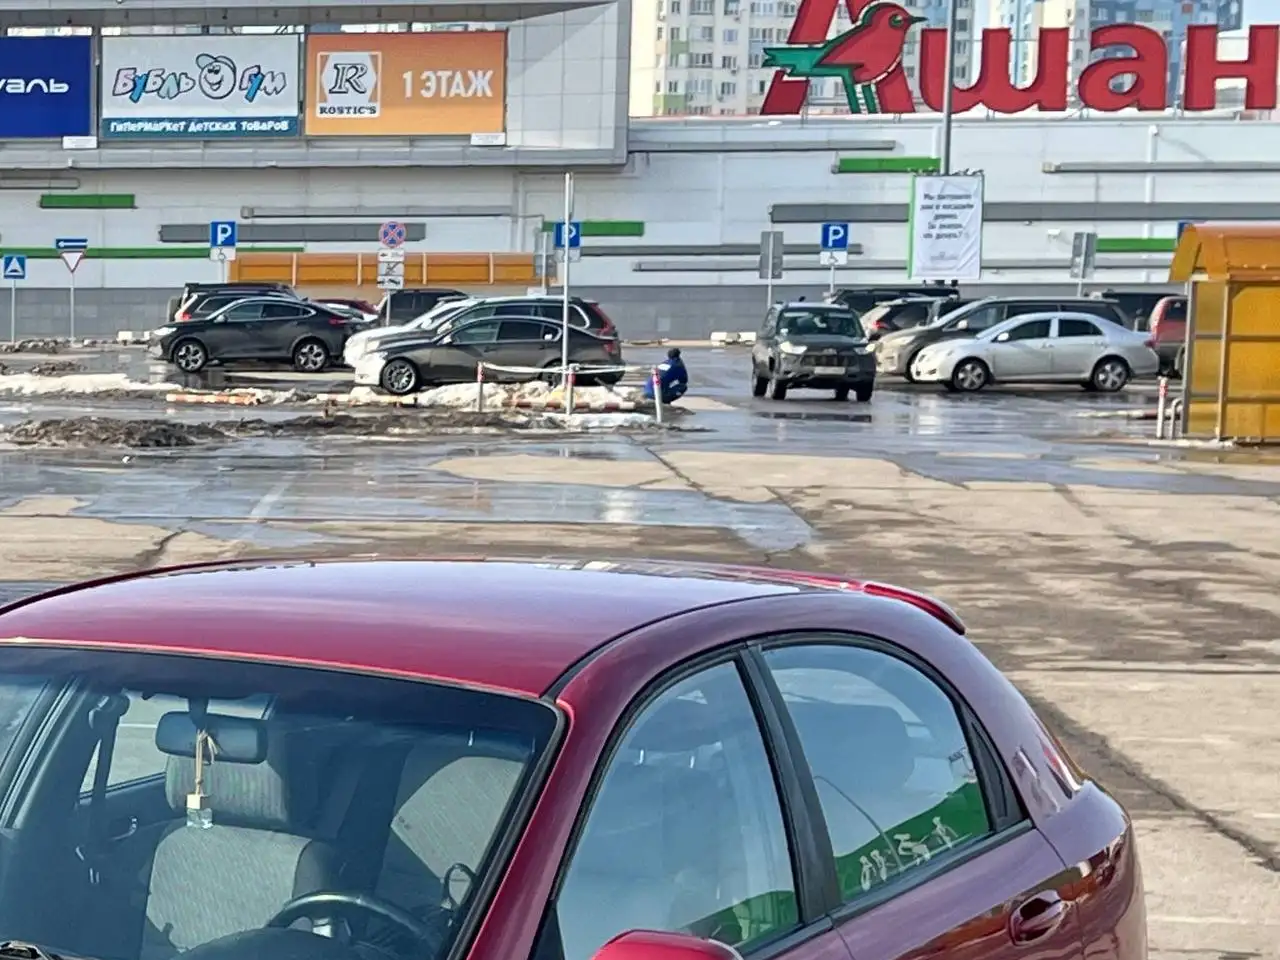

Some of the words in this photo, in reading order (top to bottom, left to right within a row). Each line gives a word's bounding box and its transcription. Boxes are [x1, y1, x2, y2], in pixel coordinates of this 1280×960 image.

[402, 70, 412, 98] 1
[420, 69, 494, 98] ЭТАЖ
[760, 0, 1279, 113] Ашан
